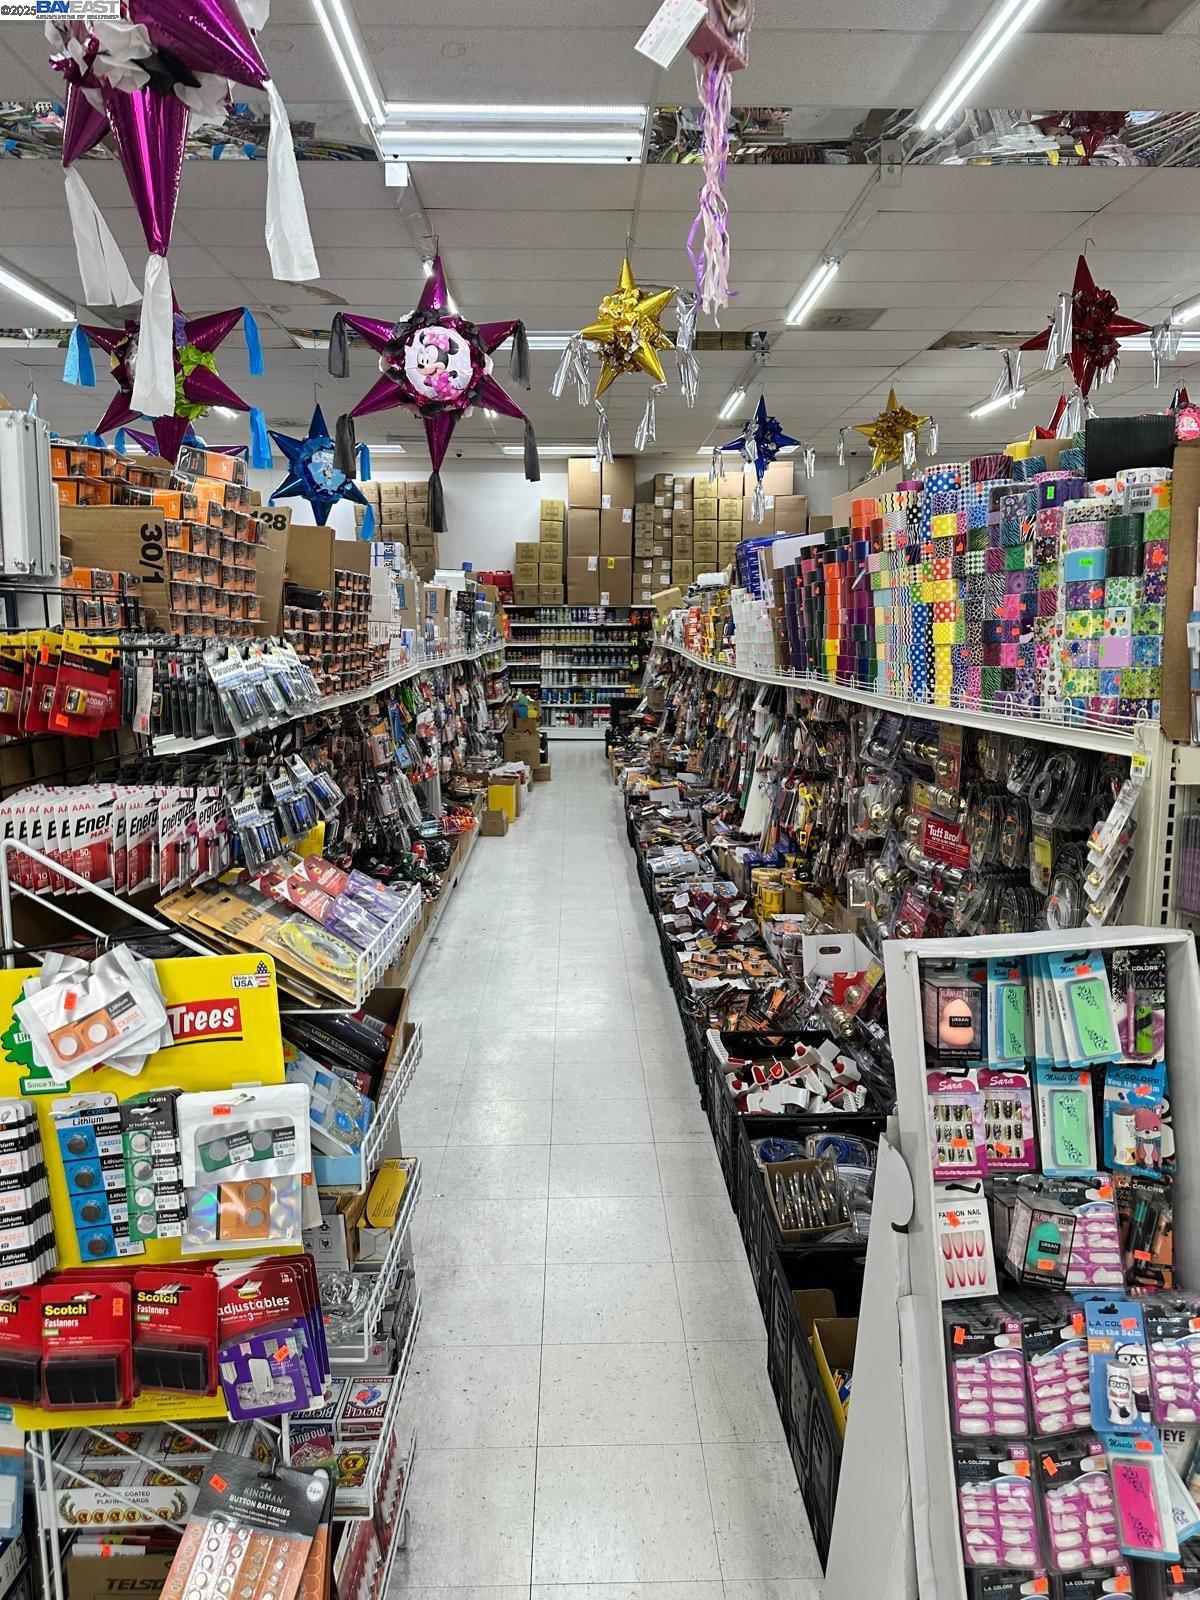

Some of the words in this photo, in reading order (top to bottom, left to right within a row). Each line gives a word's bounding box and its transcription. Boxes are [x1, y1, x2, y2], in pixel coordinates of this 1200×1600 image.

[139, 523, 164, 583] 30/1
[212, 661, 243, 678] Panasonic
[73, 803, 91, 812] AAA
[90, 827, 109, 839] MAX
[928, 824, 944, 838] Tuff
[234, 980, 254, 988] USA
[108, 998, 129, 1013] Lithium
[167, 1006, 235, 1034] Trees
[311, 1028, 329, 1043] LIGHT
[27, 1080, 48, 1088] Since
[938, 1080, 963, 1091] Sara
[989, 1075, 1014, 1086] Sara
[1123, 1080, 1137, 1088] the
[72, 1116, 104, 1126] Lithium
[229, 1135, 247, 1143] Lithium
[2, 1252, 26, 1261] Lithium
[137, 1292, 177, 1304] Scotch
[45, 1304, 87, 1315] Scotch
[137, 1304, 169, 1315] Fasteners
[218, 1296, 290, 1316] adjustables
[44, 1318, 79, 1327] Fasteners
[248, 1313, 254, 1321] 3
[344, 1402, 385, 1417] BICYCLE
[244, 1487, 284, 1503] KINGMAN
[229, 1494, 256, 1507] BUTTON
[256, 1501, 291, 1516] BATTERIES
